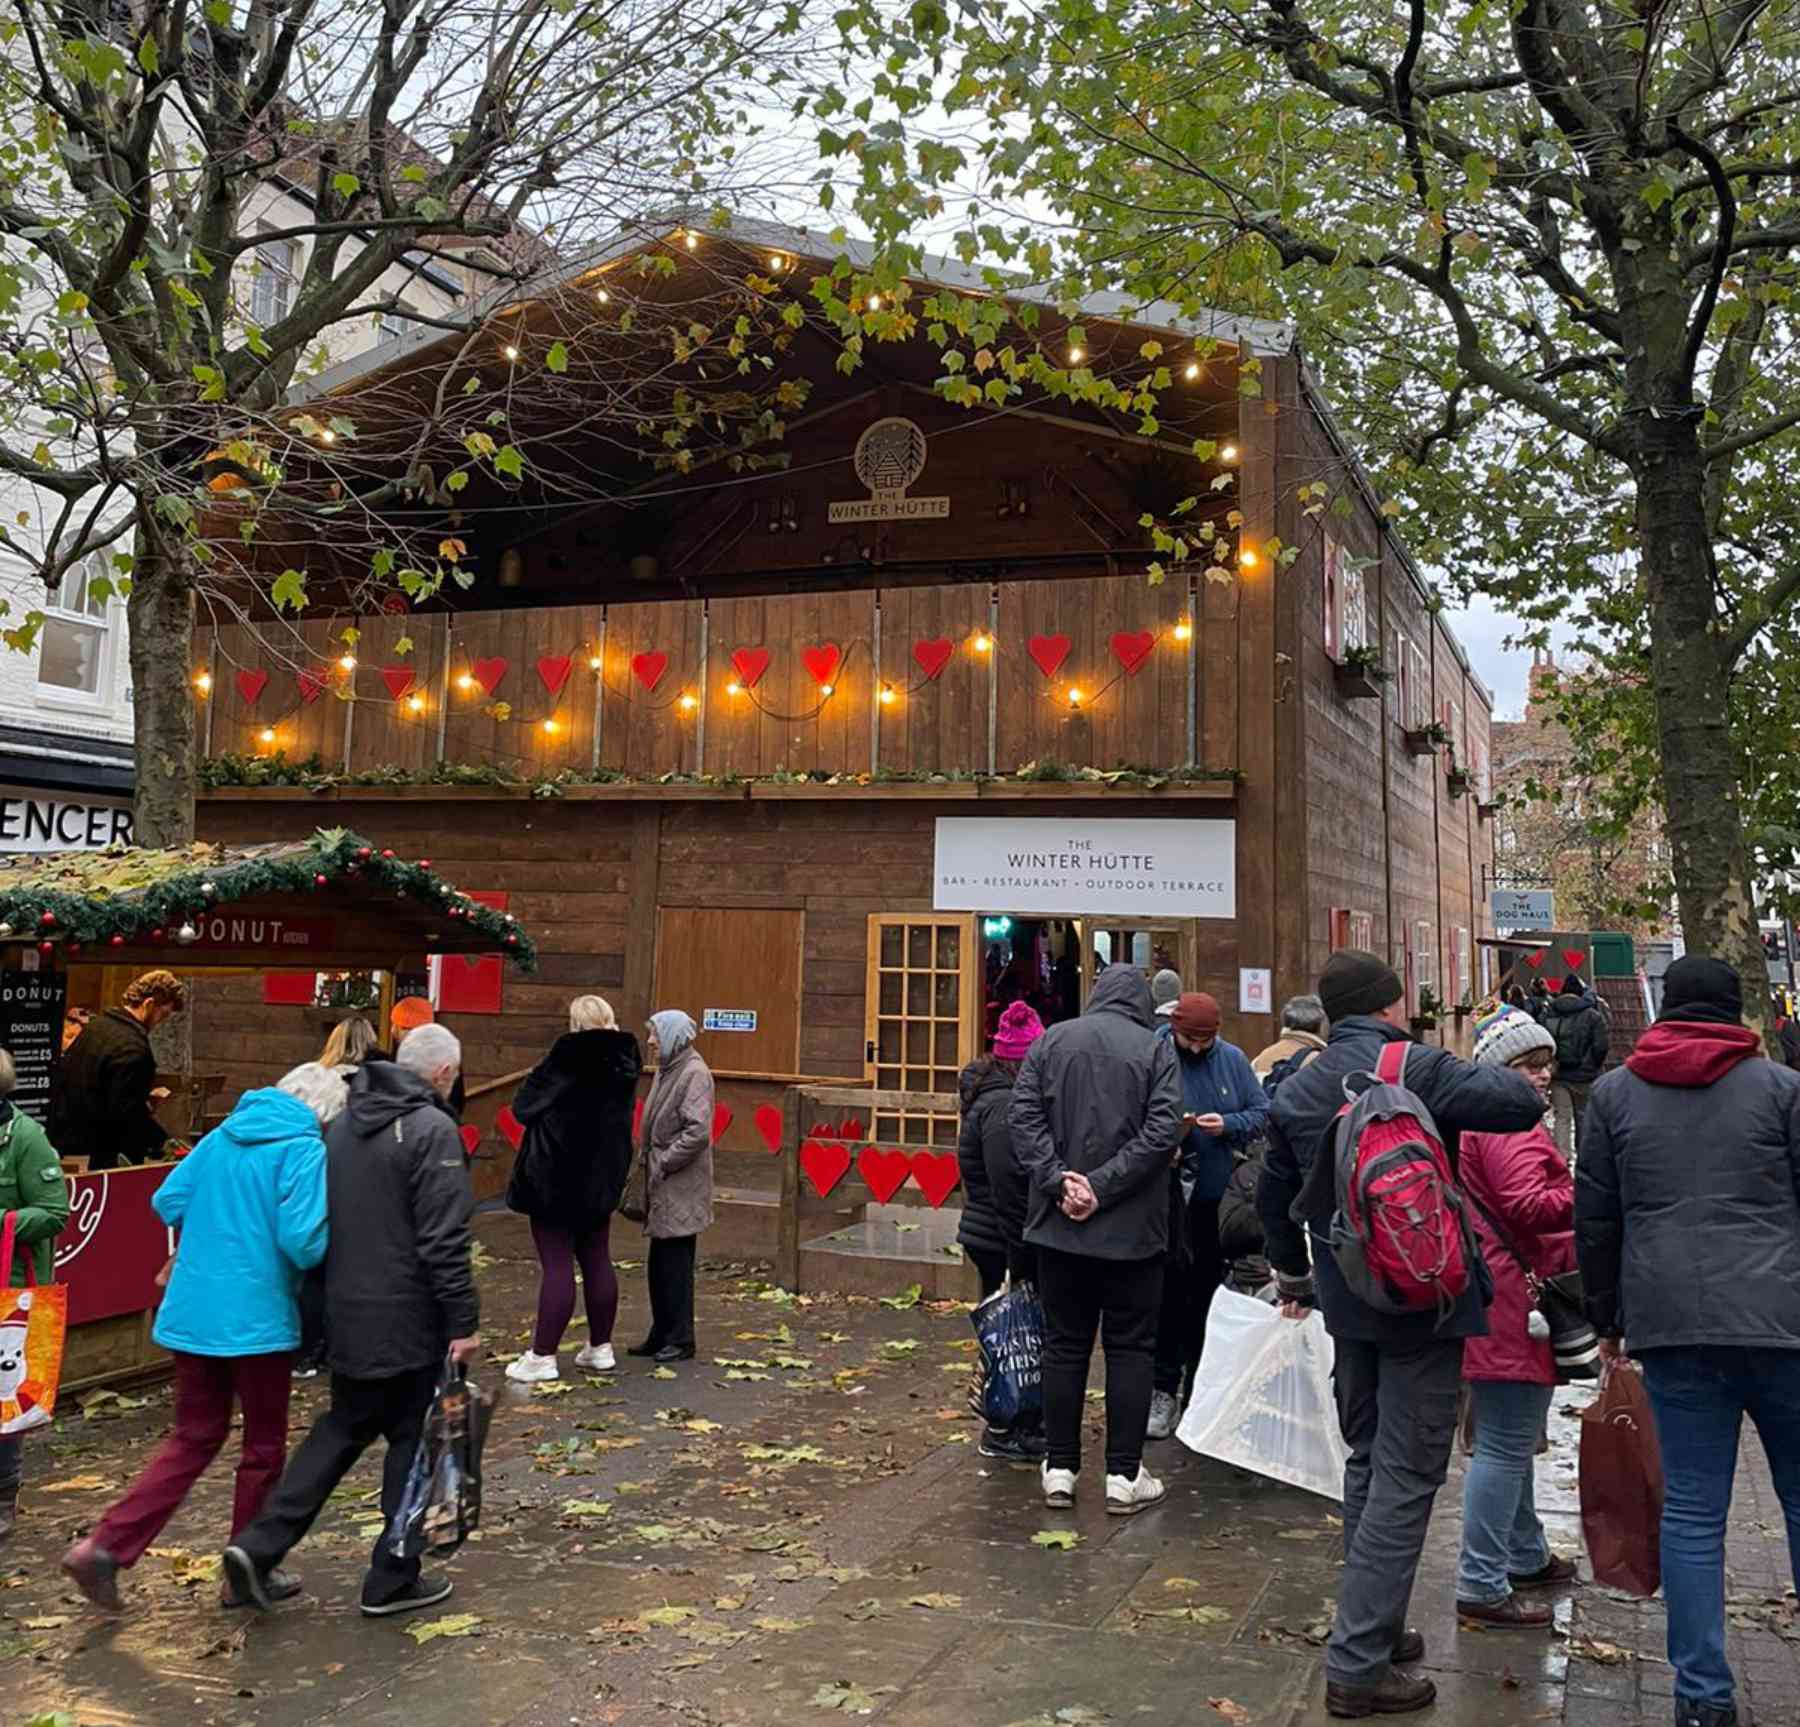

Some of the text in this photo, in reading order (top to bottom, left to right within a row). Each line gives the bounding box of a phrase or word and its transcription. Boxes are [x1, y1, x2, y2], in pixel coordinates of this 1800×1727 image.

[831, 499, 947, 518] WINTER HÜTTE
[0, 798, 134, 846] ENCER
[1068, 840, 1092, 850] THE
[1007, 852, 1154, 870] WINTER HÜTTE
[943, 876, 1224, 892] BAR RESTAURANT OUTDOOR TERRACE
[1496, 910, 1518, 919] DOG
[3, 987, 63, 1002] DONUT
[11, 1023, 50, 1033] DONUTS
